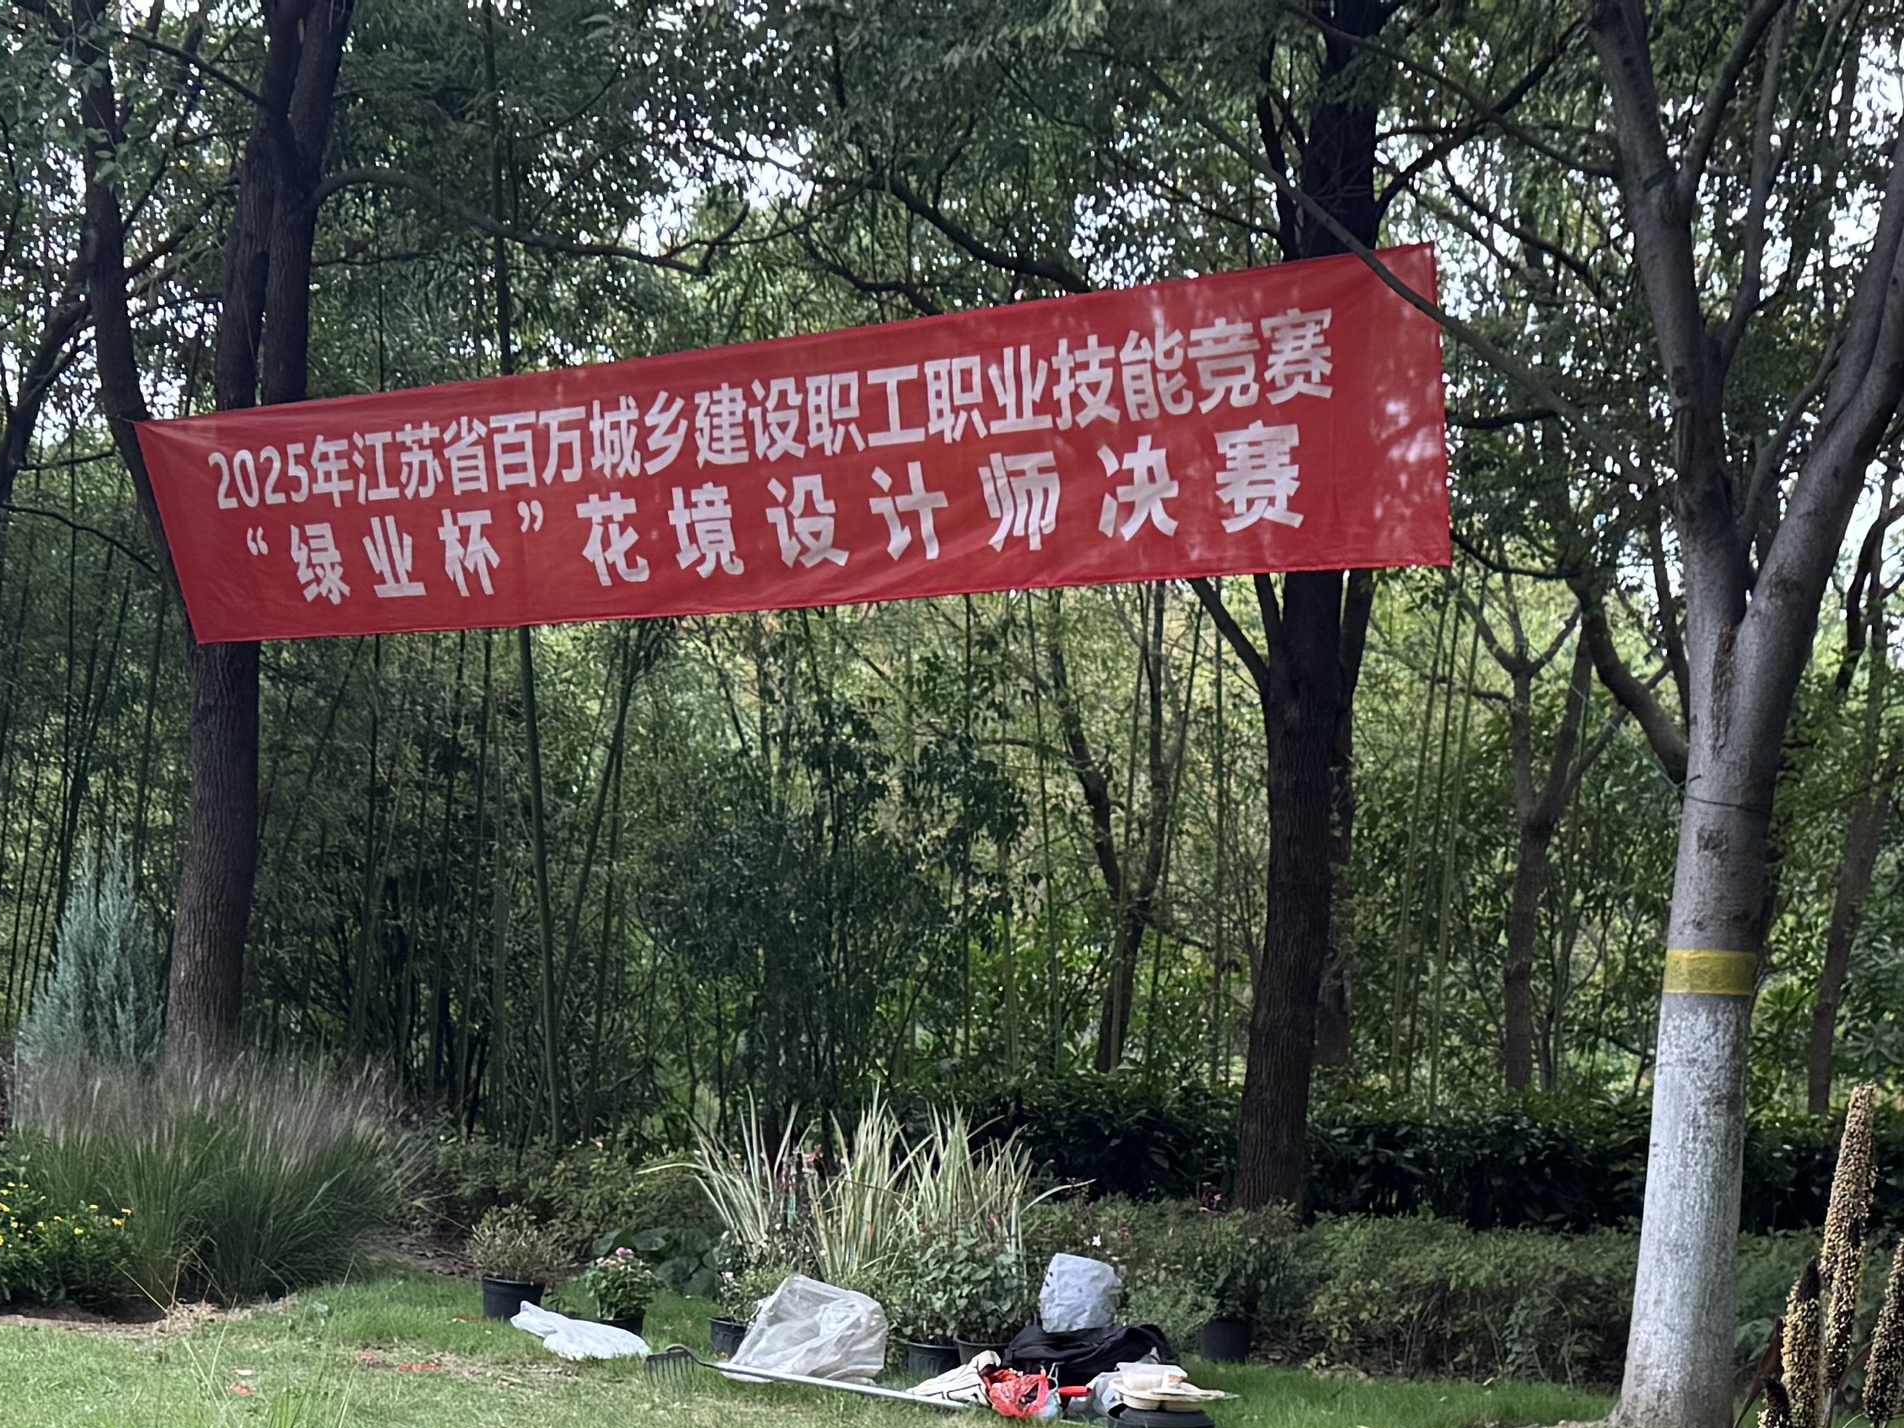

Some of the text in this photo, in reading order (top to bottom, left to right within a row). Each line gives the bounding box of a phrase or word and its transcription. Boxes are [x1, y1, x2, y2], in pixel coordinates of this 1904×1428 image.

[208, 308, 1333, 509] 2025年江苏省百万城乡建设职工职业技能竞赛
